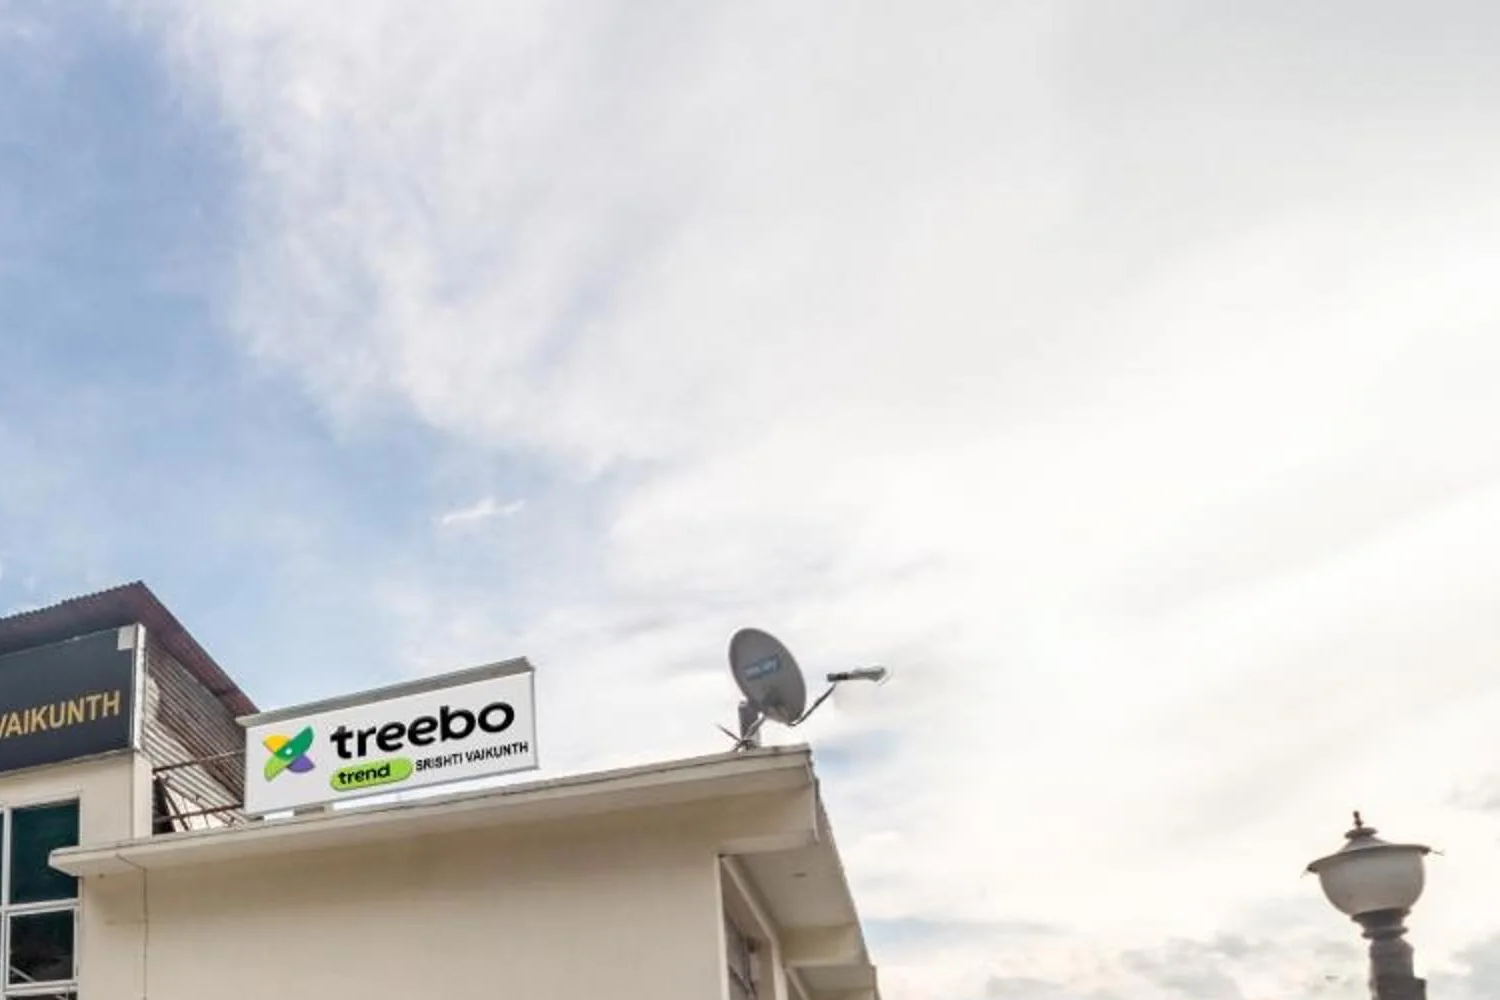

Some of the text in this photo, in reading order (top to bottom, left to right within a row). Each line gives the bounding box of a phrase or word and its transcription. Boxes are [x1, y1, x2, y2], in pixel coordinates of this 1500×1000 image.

[330, 702, 515, 759] treebo
[416, 741, 529, 771] SRISHTI VAIKUNTH
[338, 763, 391, 785] trend
